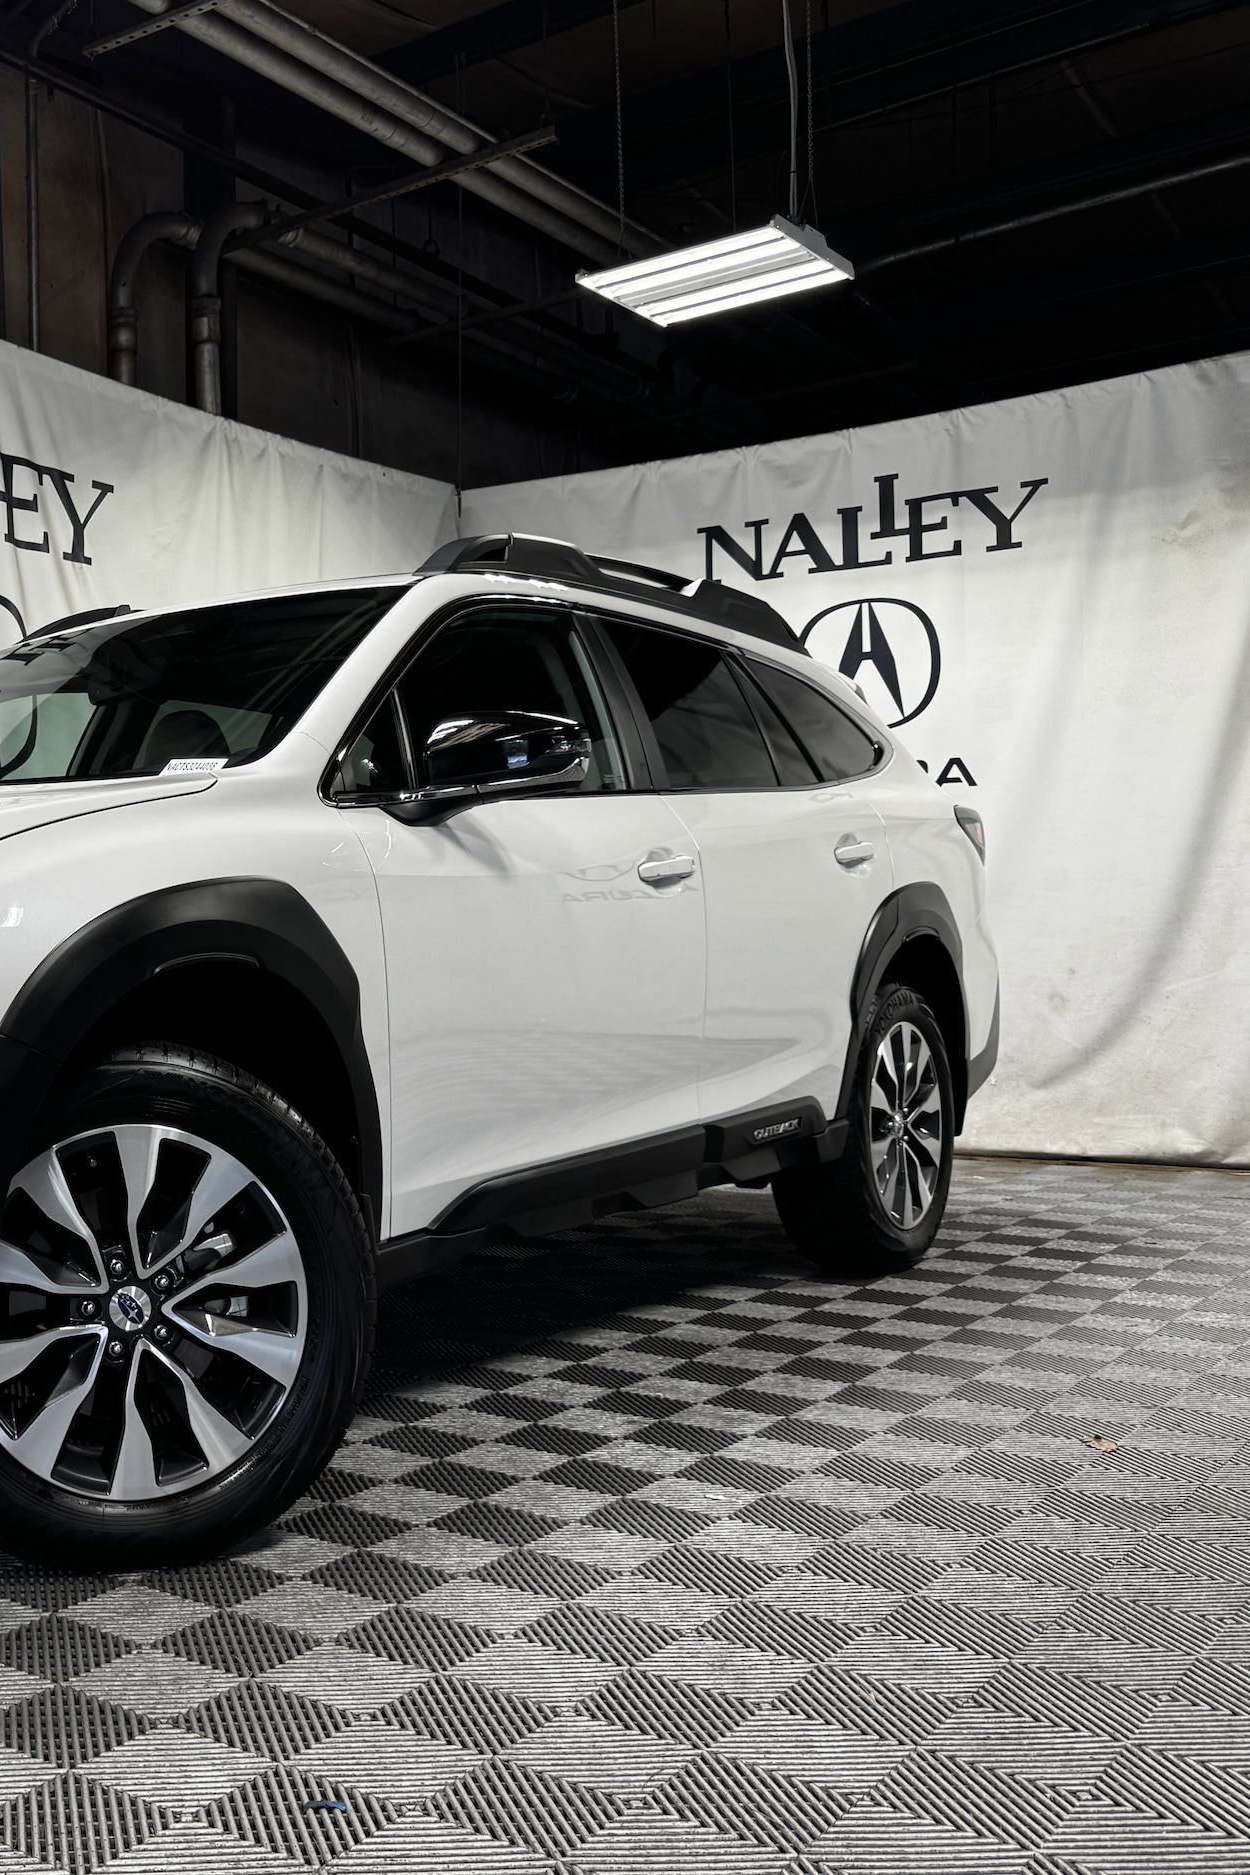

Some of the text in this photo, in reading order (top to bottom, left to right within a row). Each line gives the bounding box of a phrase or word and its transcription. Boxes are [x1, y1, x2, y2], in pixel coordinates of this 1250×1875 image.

[697, 473, 1049, 584] NALLEY
[916, 757, 978, 787] A
[873, 991, 914, 1038] YOKOHAMA
[753, 1118, 800, 1140] OUTBACK
